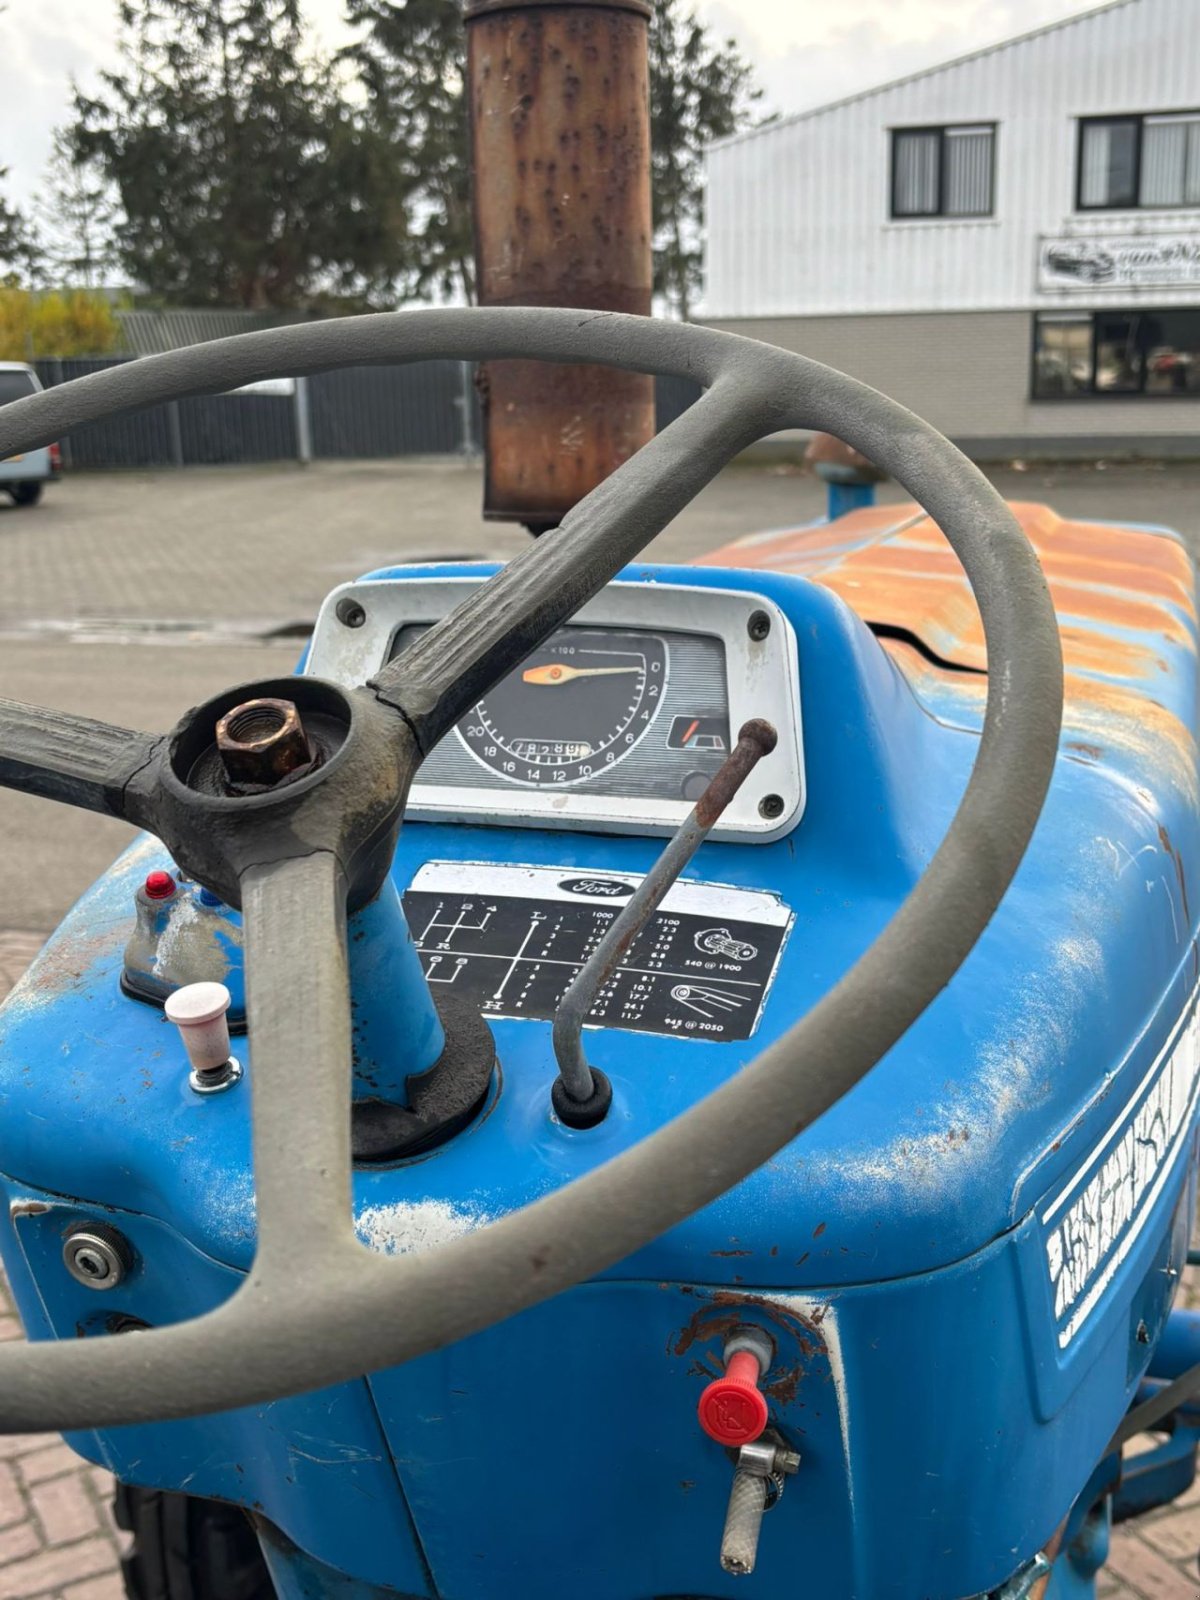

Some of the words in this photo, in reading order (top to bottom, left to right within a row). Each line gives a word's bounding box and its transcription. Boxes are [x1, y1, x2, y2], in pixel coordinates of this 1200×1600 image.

[651, 662, 660, 673] 0
[648, 685, 658, 696] 2
[640, 710, 649, 720] 4
[466, 725, 485, 737] 20
[625, 733, 634, 744] 6
[484, 746, 497, 757] 18
[605, 752, 615, 762] 8
[502, 761, 516, 772] 16
[578, 765, 592, 775] 10
[527, 769, 540, 780] 14
[552, 770, 566, 781] 12
[572, 880, 623, 895] Ford
[530, 911, 547, 920] L
[592, 911, 614, 919] 1000
[656, 918, 681, 926] 2100
[659, 934, 673, 942] 2.8
[436, 942, 451, 950] R
[641, 975, 656, 983] 8.1
[633, 984, 652, 992] 10.1
[482, 1000, 504, 1010] H
[623, 1002, 644, 1010] 24.1
[698, 1023, 724, 1032] 2050
